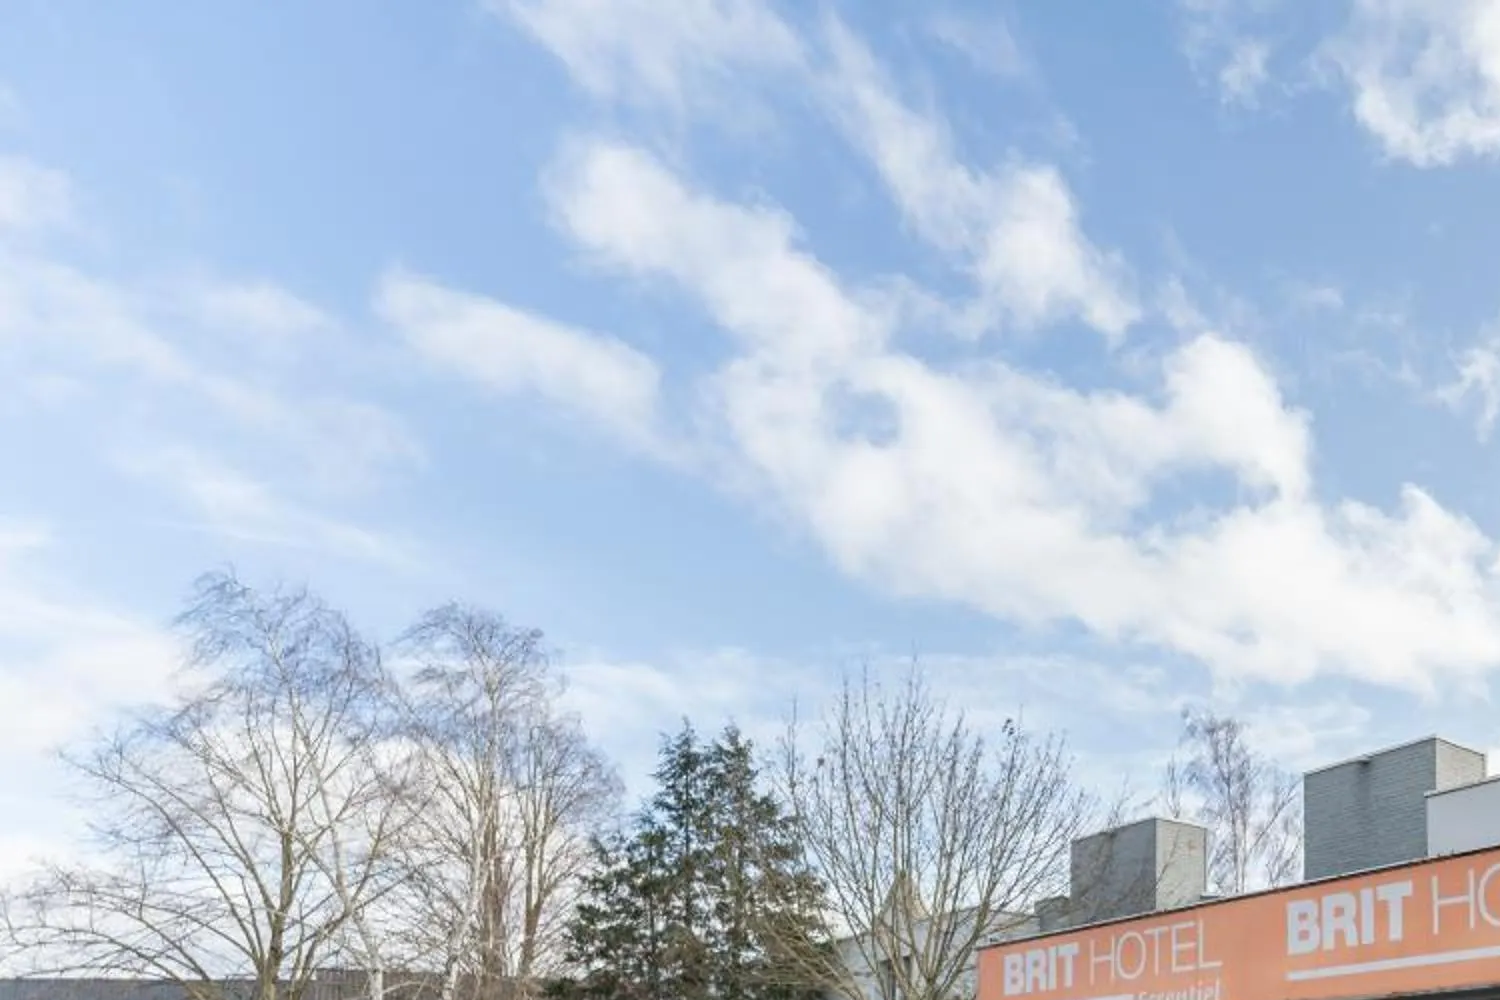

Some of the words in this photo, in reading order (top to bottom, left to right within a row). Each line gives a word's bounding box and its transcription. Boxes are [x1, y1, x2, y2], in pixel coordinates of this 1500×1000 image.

[1287, 881, 1413, 956] BRIT
[1003, 943, 1080, 996] BRIT
[1089, 921, 1223, 986] HOTEL
